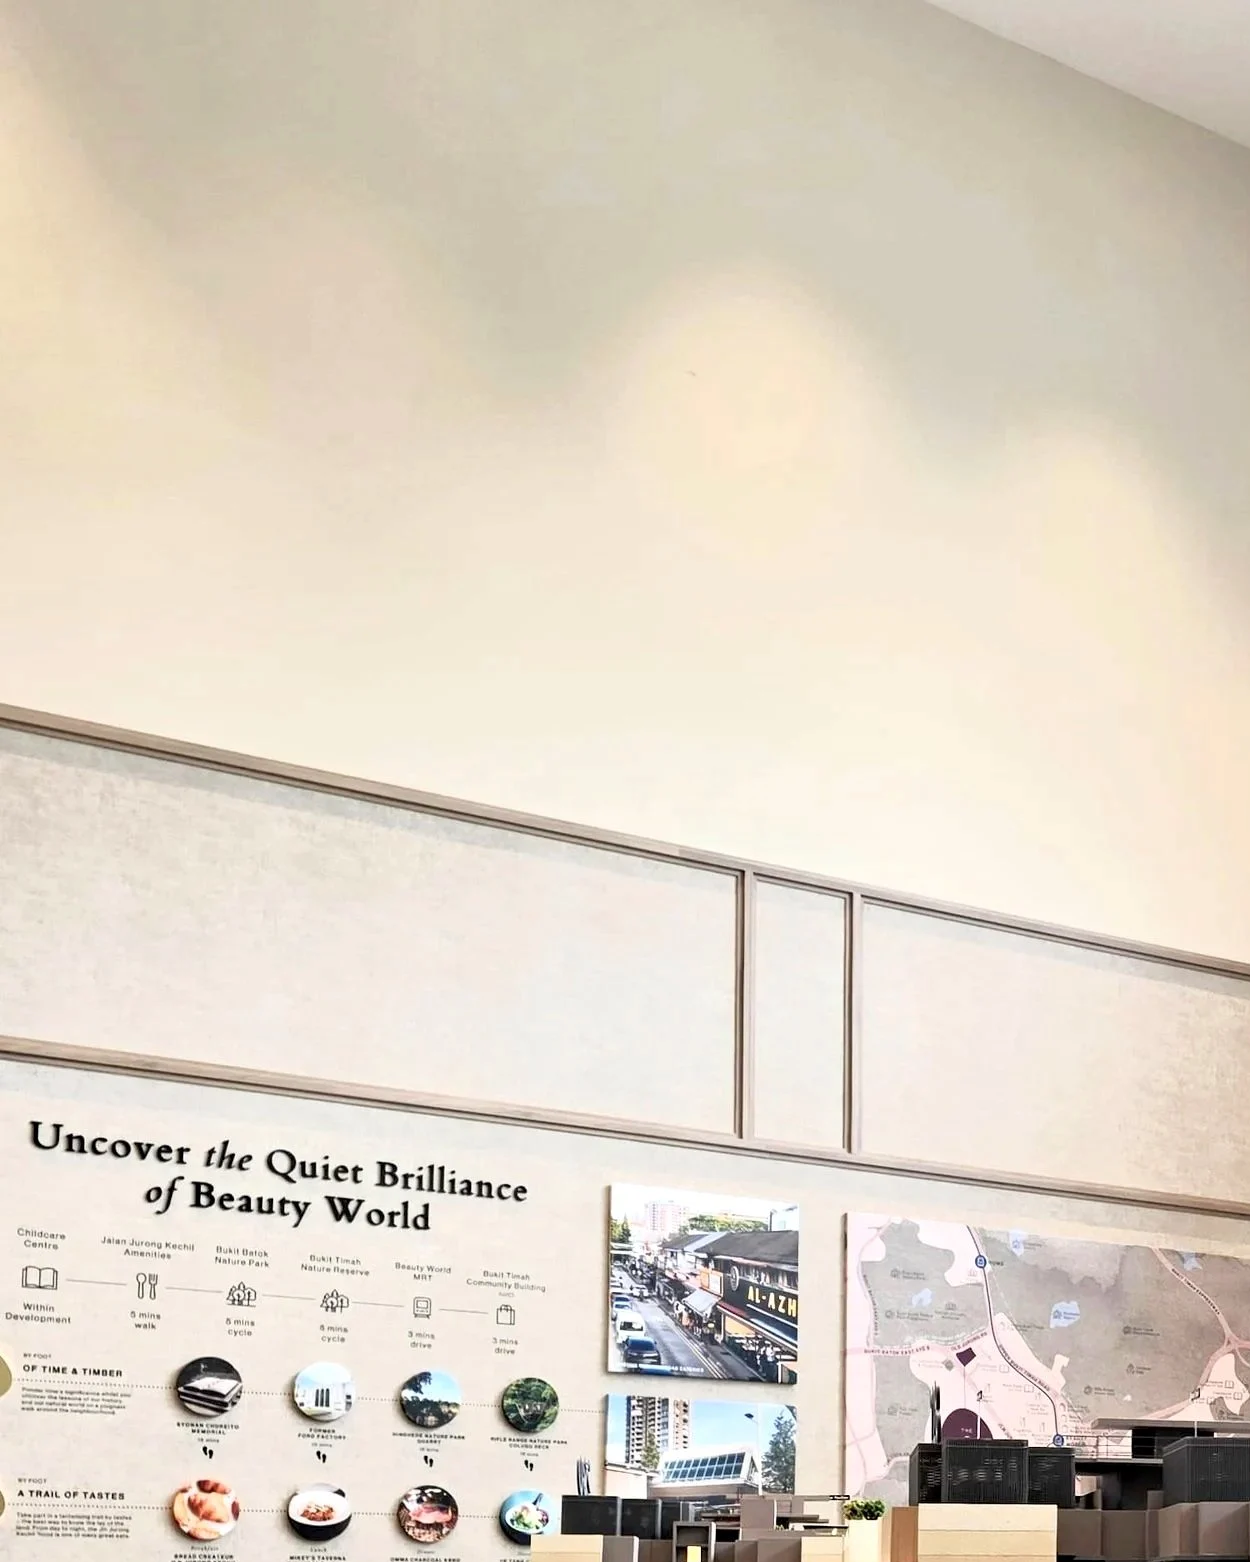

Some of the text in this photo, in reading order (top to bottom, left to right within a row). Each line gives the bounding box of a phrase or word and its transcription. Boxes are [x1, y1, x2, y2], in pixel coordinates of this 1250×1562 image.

[29, 1120, 529, 1203] Uncover the Quiet Brilliance
[144, 1176, 431, 1233] of Beauty World
[17, 1228, 66, 1240] Childcare
[24, 1239, 59, 1250] Centre
[101, 1236, 195, 1251] Jalan Jurong Kechil
[124, 1249, 171, 1260] Amenities
[216, 1246, 269, 1258] Bukit Batok
[215, 1256, 269, 1268] Nature Park
[310, 1255, 361, 1265] Bukit Timah
[301, 1263, 370, 1276] Nature Reserve
[395, 1262, 451, 1274] Beauty World
[413, 1273, 432, 1282] MRT
[483, 1270, 504, 1279] Bukit
[466, 1278, 546, 1293] Community Building
[747, 1285, 798, 1318] AL-AZH
[23, 1303, 55, 1312] Within
[5, 1312, 71, 1324] Development
[138, 1311, 161, 1320] mins
[134, 1321, 156, 1330] walk
[233, 1318, 255, 1327] mins
[228, 1328, 252, 1337] cycle
[327, 1325, 348, 1333] mins
[321, 1335, 345, 1343] cycle
[410, 1341, 432, 1349] drive
[495, 1347, 515, 1355] drive
[23, 1364, 38, 1373] OF
[42, 1365, 68, 1375] TIME
[82, 1368, 123, 1378] TIMBER
[29, 1489, 61, 1499] TRAIL
[64, 1491, 79, 1499] OF
[83, 1491, 125, 1501] TASTES
